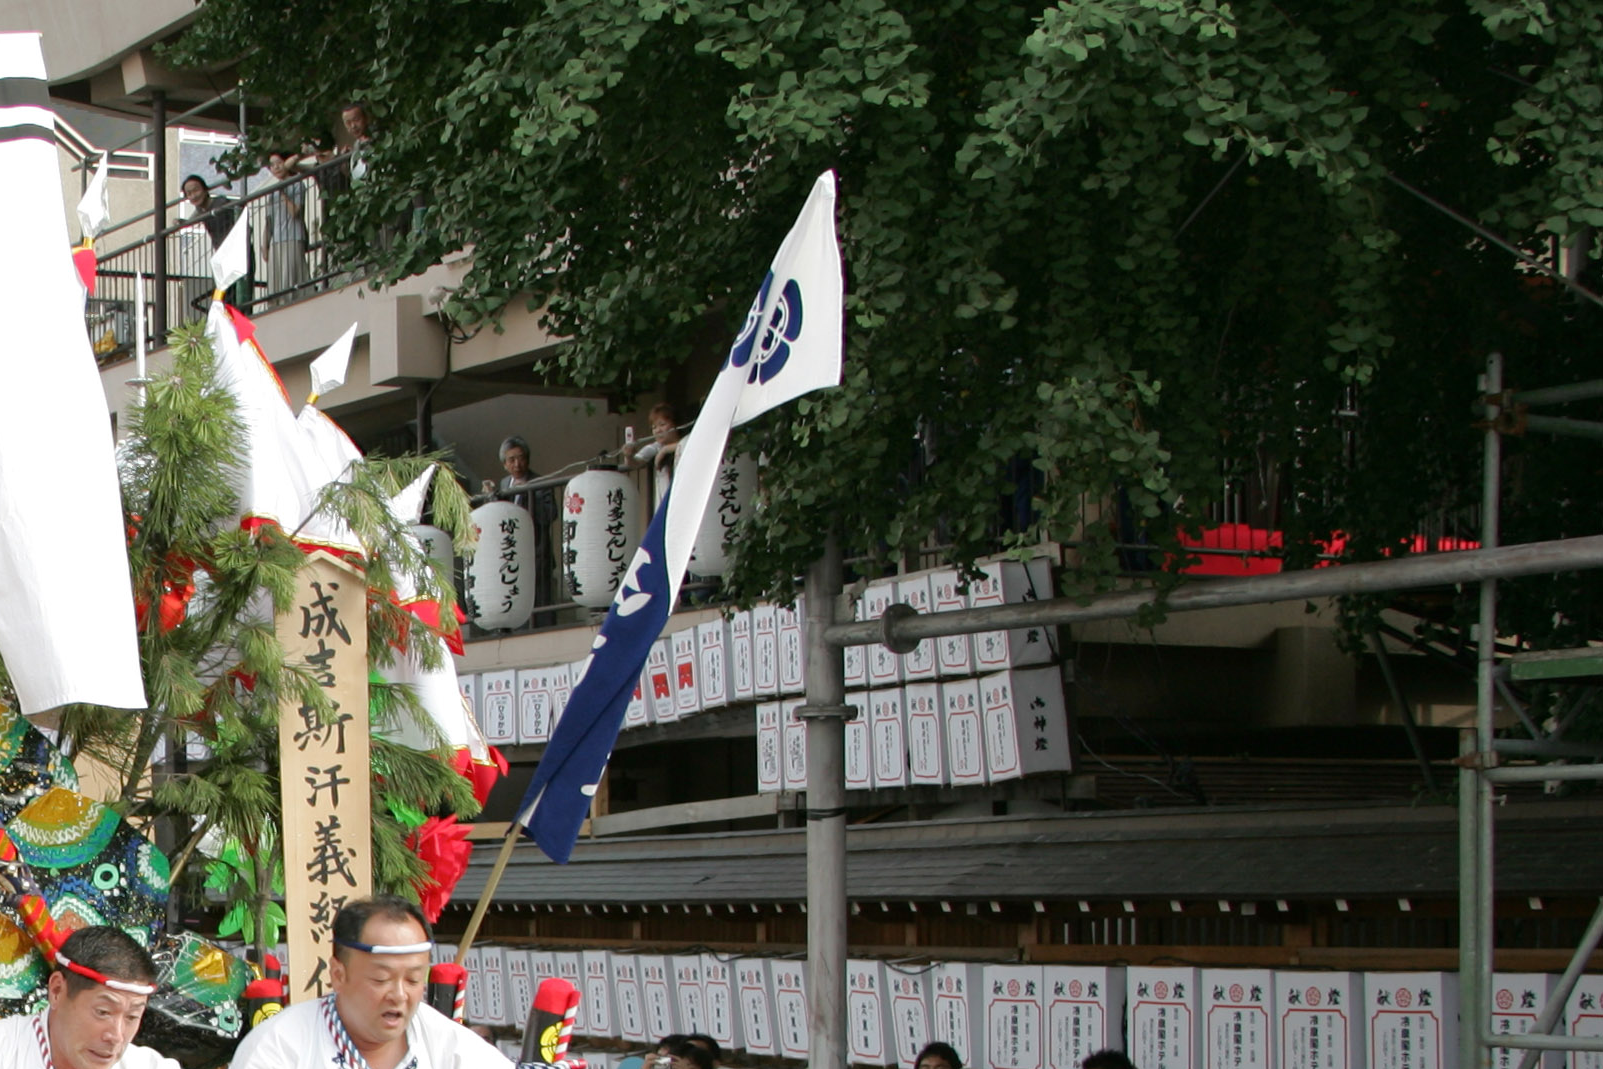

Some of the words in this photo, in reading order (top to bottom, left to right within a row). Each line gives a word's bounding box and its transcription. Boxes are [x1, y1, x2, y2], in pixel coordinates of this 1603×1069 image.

[499, 518, 520, 614] 博多せんしょう
[606, 488, 627, 592] 博多せんしょう
